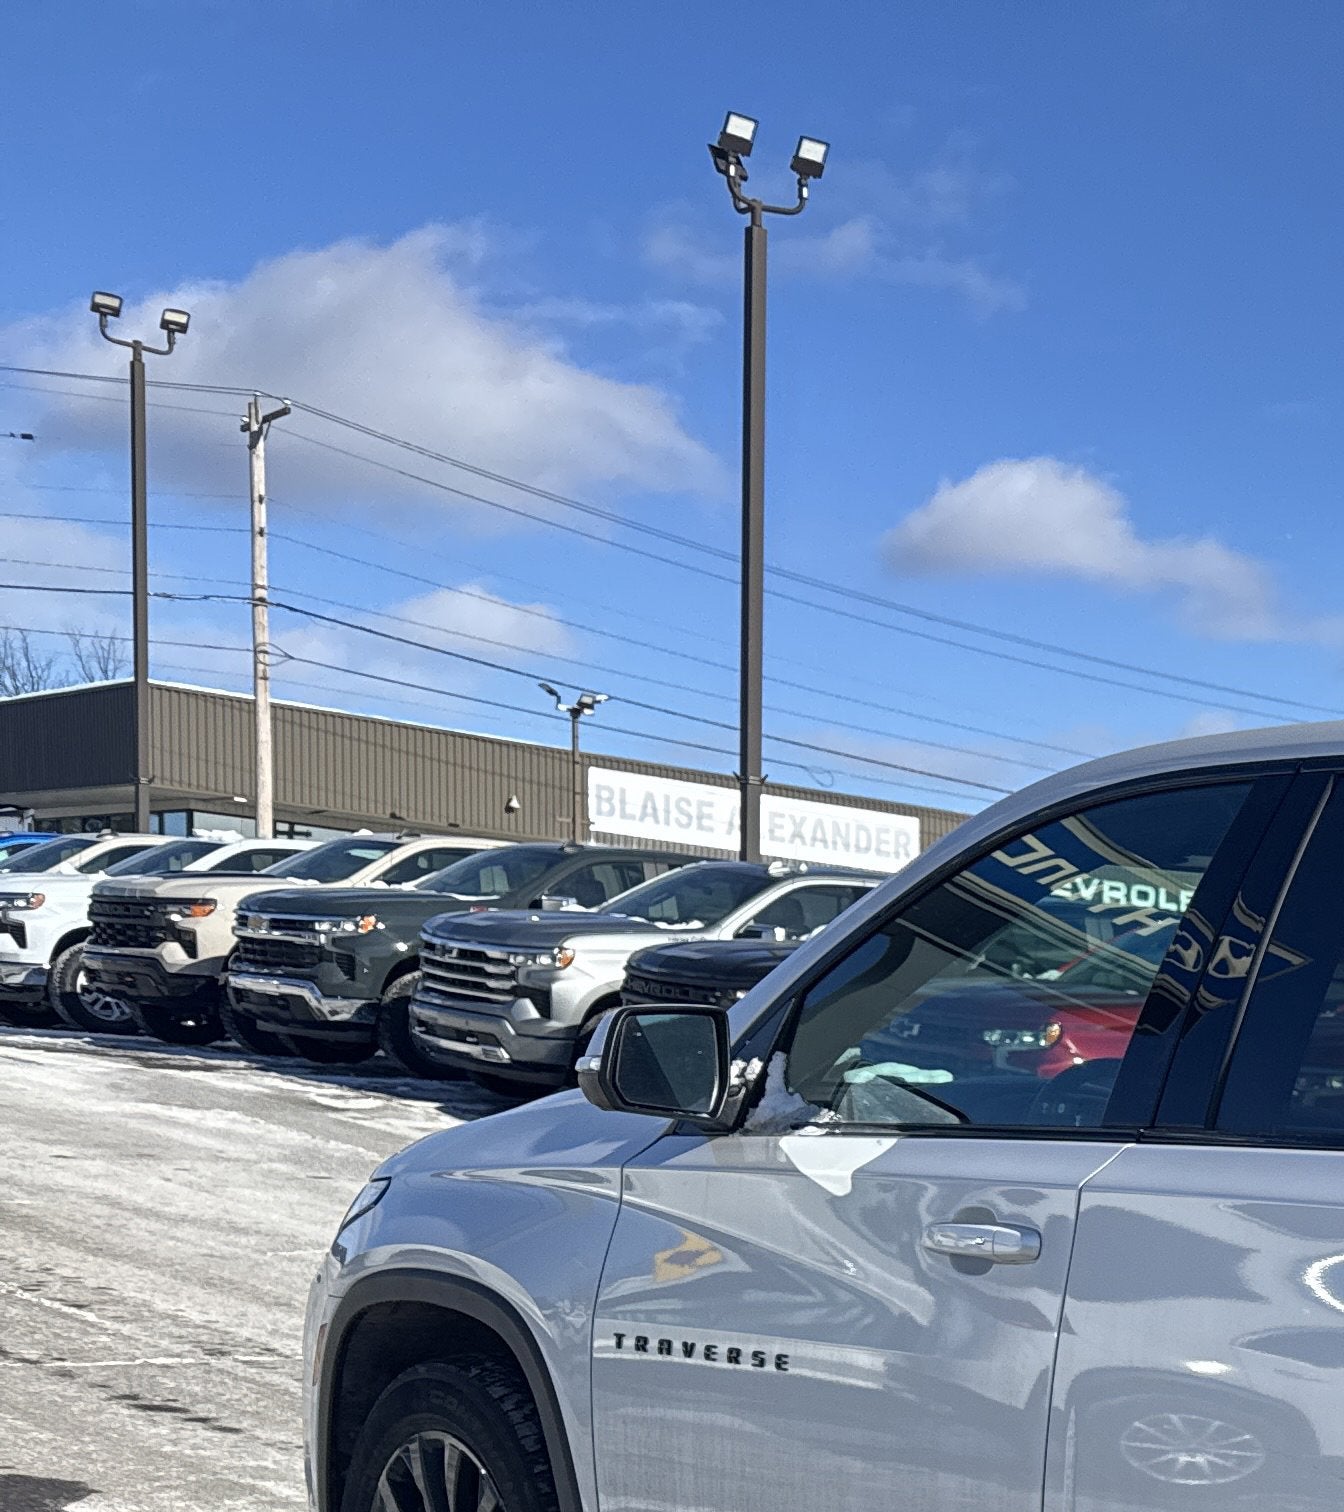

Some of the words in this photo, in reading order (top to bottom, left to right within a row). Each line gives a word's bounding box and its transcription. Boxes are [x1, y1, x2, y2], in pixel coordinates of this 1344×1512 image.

[595, 784, 715, 833] BLAISE
[726, 805, 911, 859] AEXANDER
[613, 1332, 790, 1372] TRAVERSE
